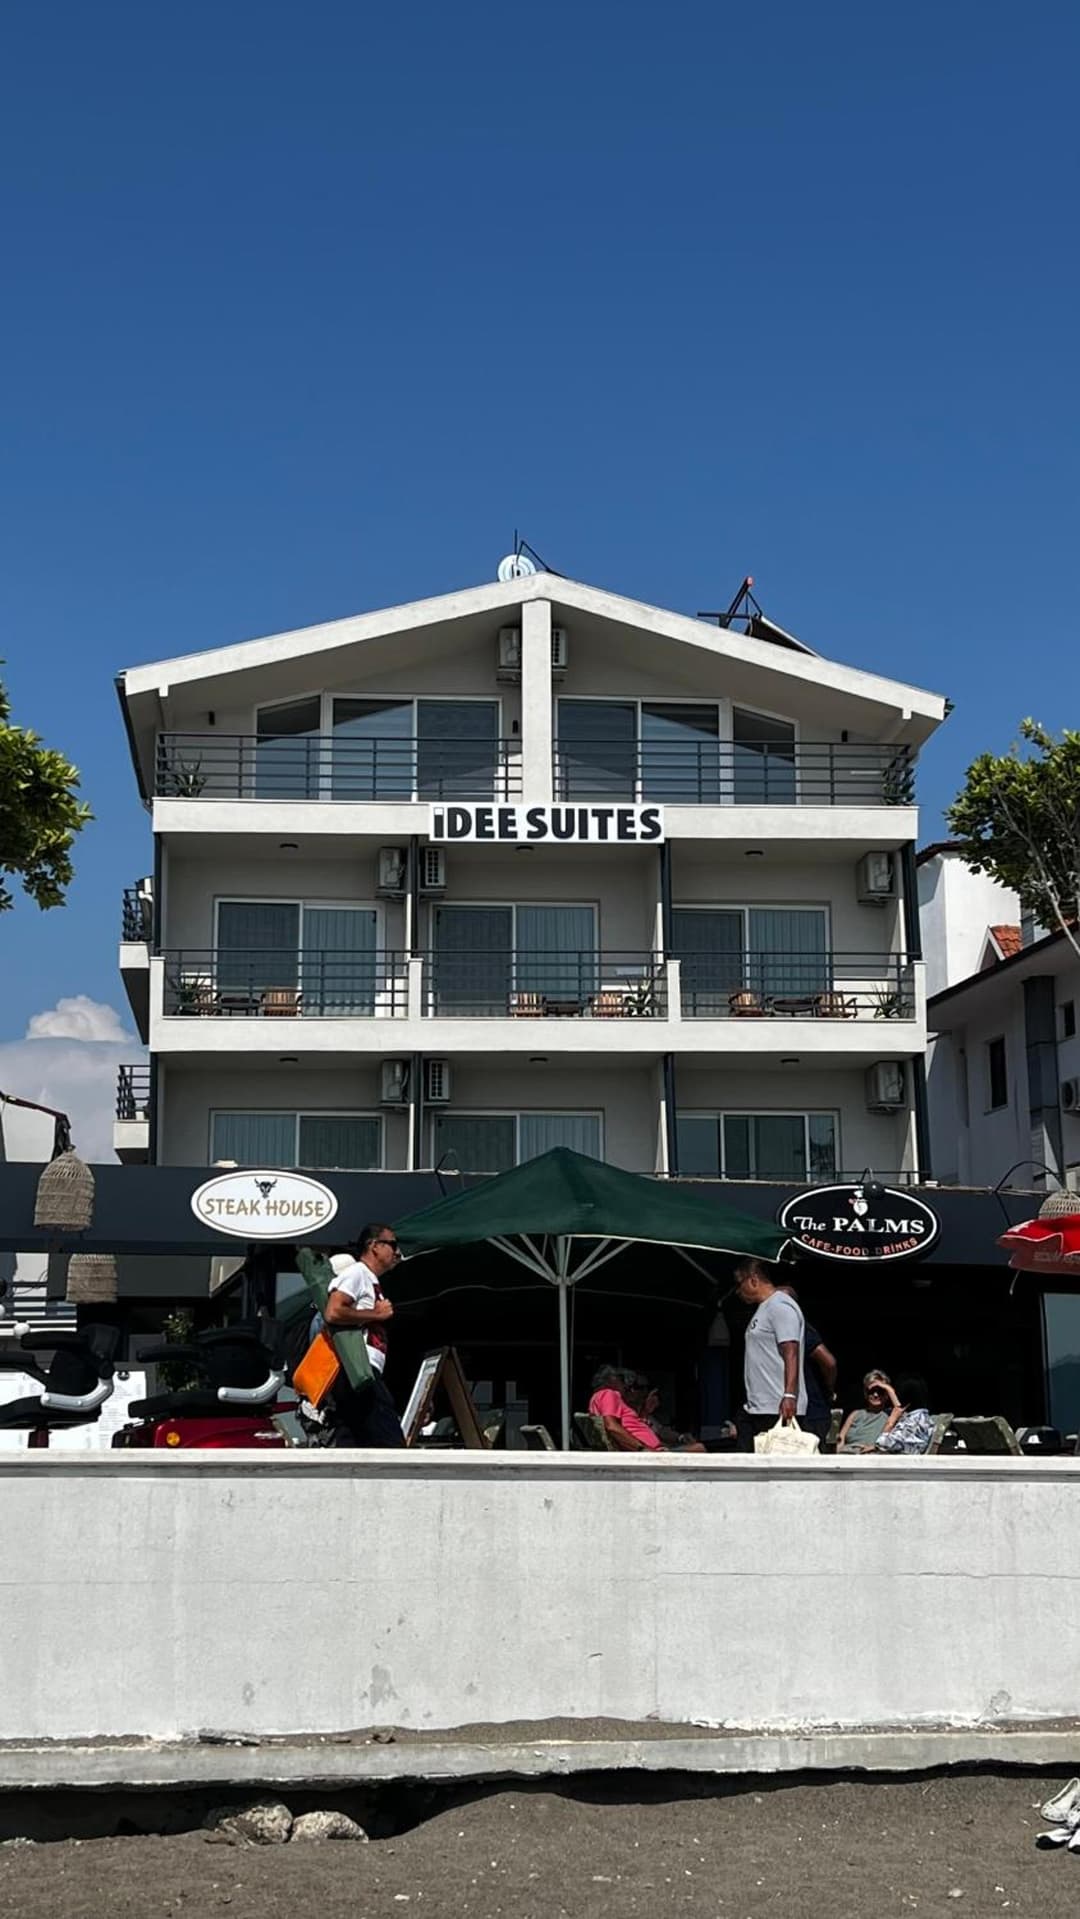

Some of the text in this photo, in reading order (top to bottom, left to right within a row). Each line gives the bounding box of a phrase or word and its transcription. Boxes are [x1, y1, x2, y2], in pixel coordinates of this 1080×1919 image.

[526, 807, 662, 840] SUITES
[204, 1198, 325, 1218] STEAK HOUSE
[793, 1216, 925, 1234] The PALMS
